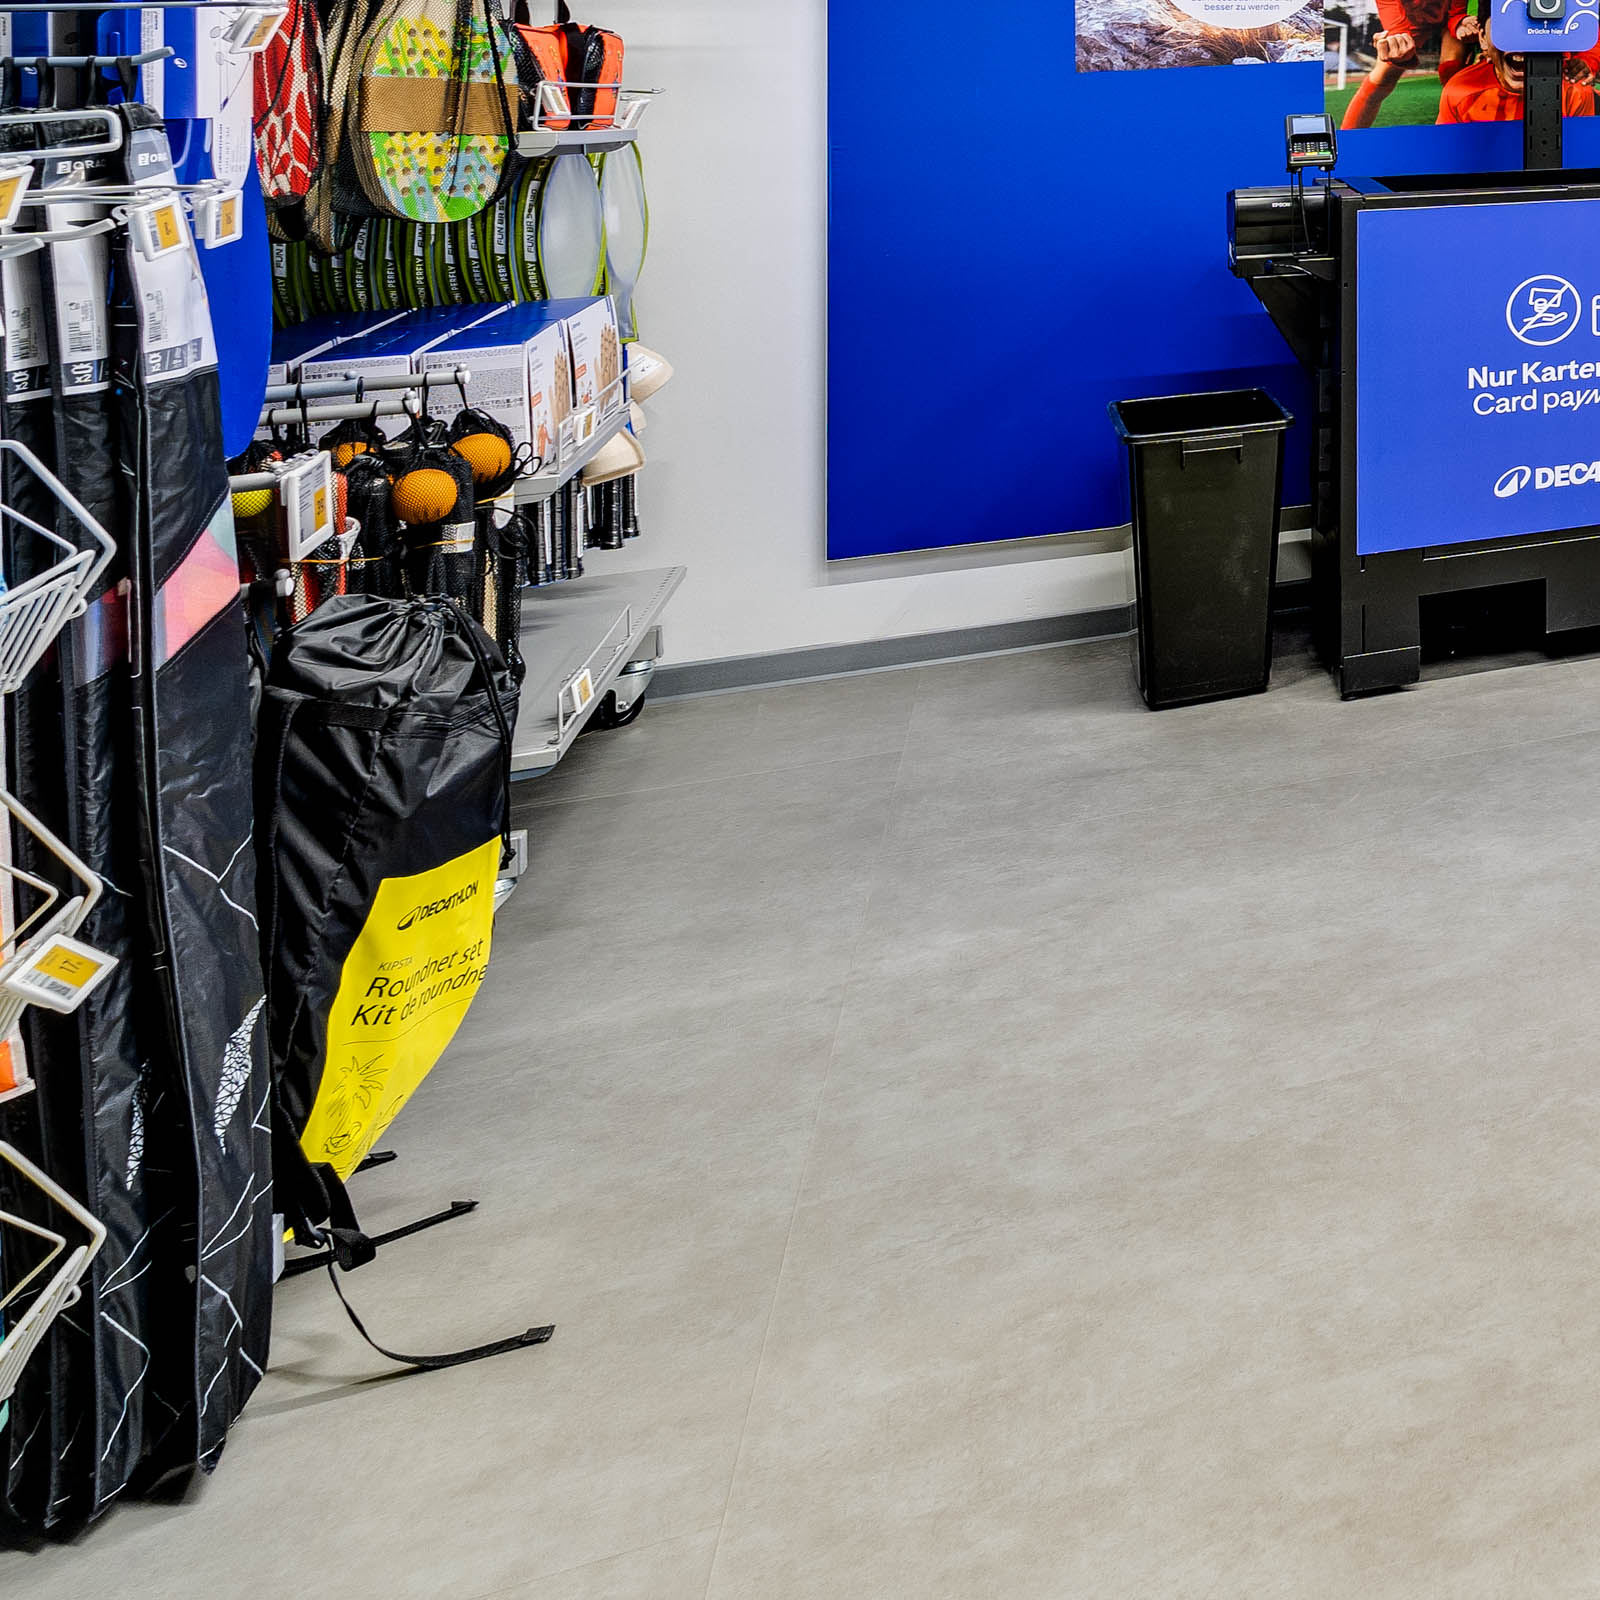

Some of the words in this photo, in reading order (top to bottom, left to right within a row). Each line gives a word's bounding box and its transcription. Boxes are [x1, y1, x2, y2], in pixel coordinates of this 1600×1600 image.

[526, 234, 535, 254] FUN
[355, 260, 364, 288] PERFLY
[416, 257, 424, 285] PERFLY
[472, 259, 481, 286] PERFLY
[528, 263, 539, 289] PERFLY
[1468, 367, 1517, 389] Nur
[1473, 389, 1537, 416] Card
[419, 880, 479, 921] DECATHLON
[378, 957, 413, 972] KIPSTA
[458, 938, 484, 966] set
[365, 950, 459, 998] Roundnet
[350, 1004, 398, 1026] Kit
[400, 996, 416, 1021] de
[418, 964, 488, 1009] roundne
